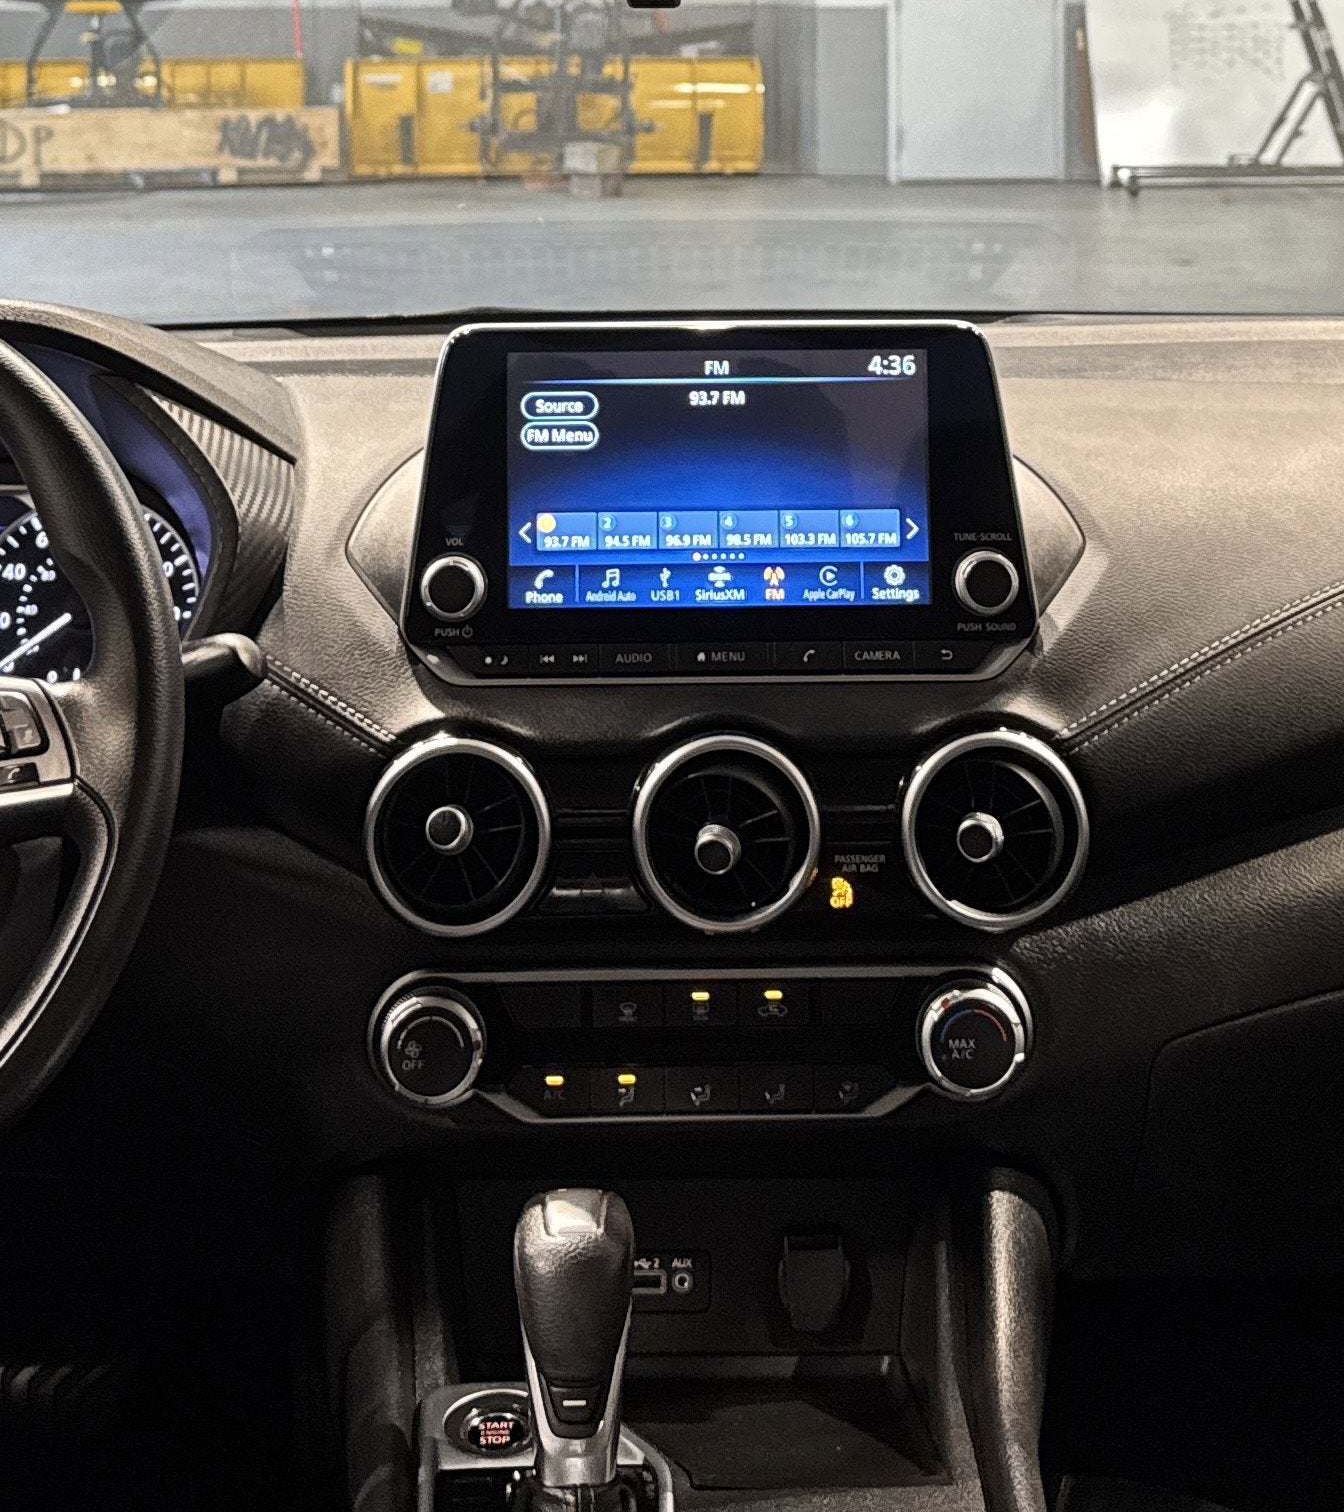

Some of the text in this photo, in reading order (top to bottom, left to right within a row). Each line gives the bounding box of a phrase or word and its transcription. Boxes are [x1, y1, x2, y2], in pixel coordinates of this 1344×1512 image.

[703, 354, 917, 377] FM 4:36
[688, 390, 746, 406] 93.7 FM
[535, 398, 585, 415] Source
[526, 428, 595, 444] FM Menu
[444, 537, 465, 547] VOL
[543, 536, 591, 548] 93.7 FM
[604, 535, 651, 547] 94.5 FM
[665, 534, 713, 547] 96.9 FM
[725, 533, 773, 546] 98.5 FM
[784, 532, 837, 546] 103.3 FM
[845, 532, 898, 545] 105.7 FM
[1, 563, 27, 581] 40
[525, 590, 564, 605] Phone
[585, 590, 638, 602] Android Auto
[650, 589, 681, 601] USB1
[694, 588, 746, 601] SiriusXM
[765, 588, 786, 600] FM
[803, 588, 856, 602] Apple CarPlay
[871, 587, 921, 603] Settings
[434, 627, 460, 637] PUSH
[956, 622, 1017, 632] PUSH SOUND
[615, 653, 653, 664] AUDIO
[710, 651, 747, 662] MENU
[854, 650, 901, 662] CAMERA
[834, 854, 886, 864] PASSENGER
[841, 863, 879, 873] AIR BAG
[948, 1037, 976, 1049] MAX
[951, 1049, 975, 1060] A/C
[402, 1059, 424, 1071] OFF
[543, 1090, 566, 1101] A/C
[671, 1257, 693, 1269] AUX
[478, 1421, 515, 1430] START
[479, 1435, 511, 1445] STOP
